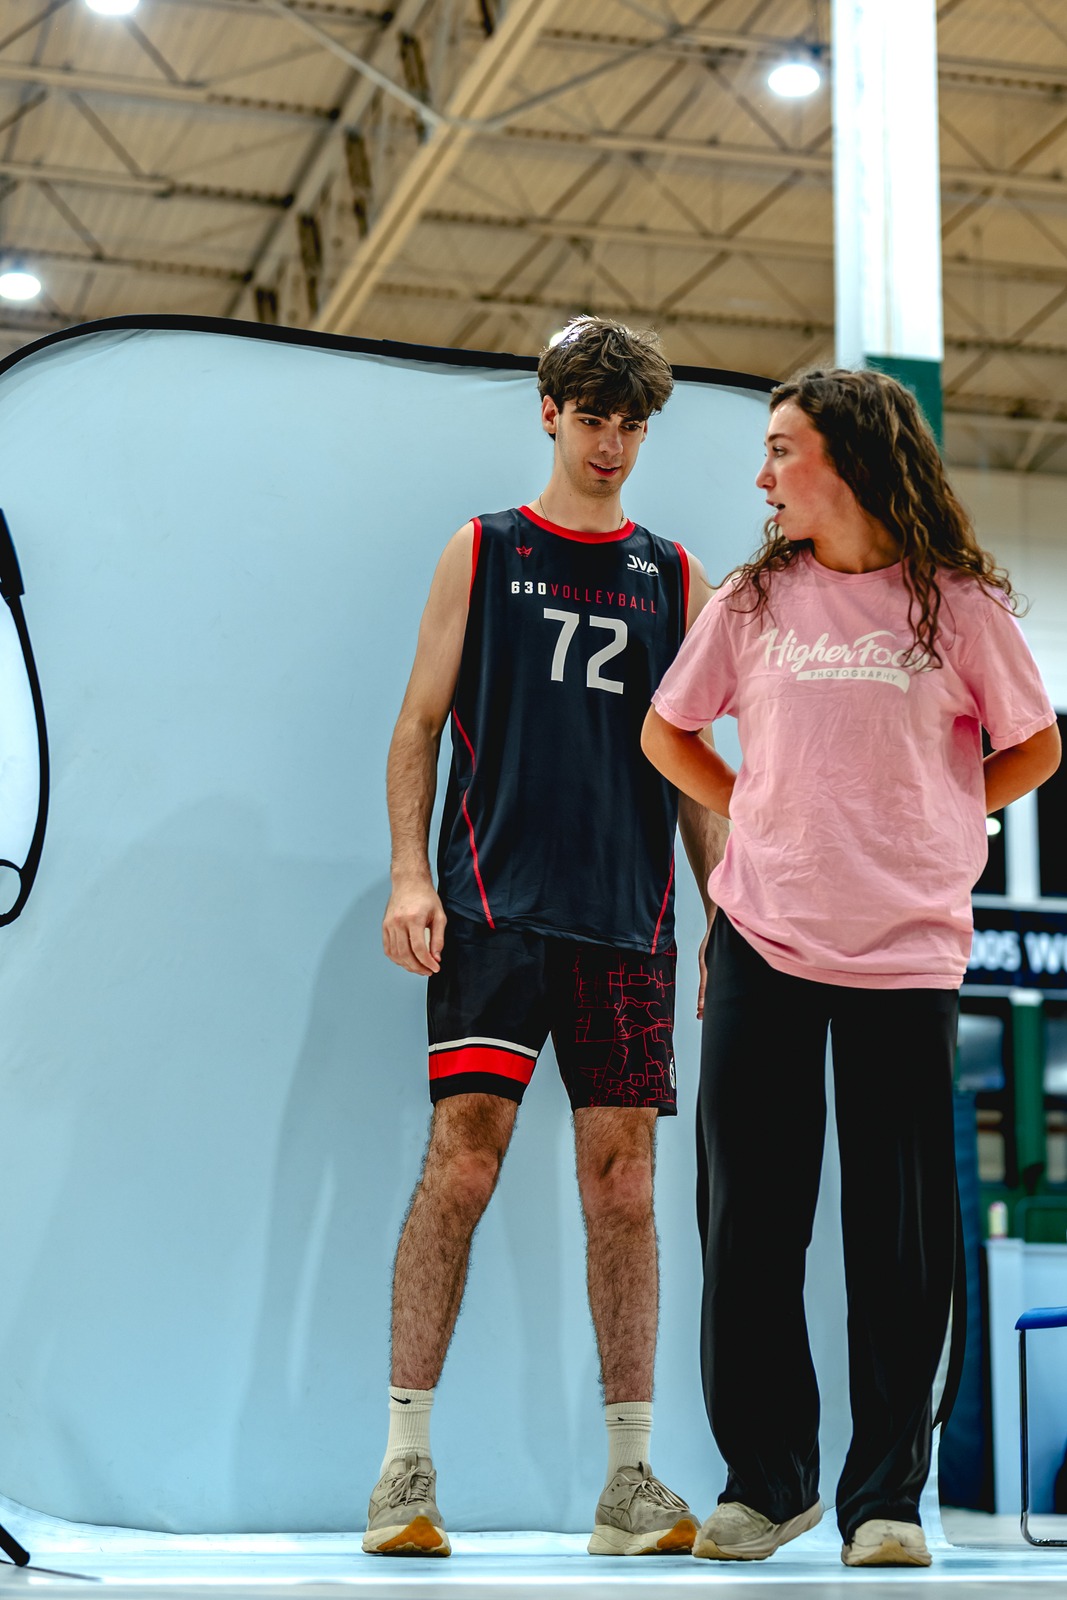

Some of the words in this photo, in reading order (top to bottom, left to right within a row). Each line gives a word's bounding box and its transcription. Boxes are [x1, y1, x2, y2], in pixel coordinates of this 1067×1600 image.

[627, 554, 659, 575] JVA
[543, 607, 628, 694] 72
[759, 628, 856, 673] Higher
[810, 669, 898, 682] PHOTOGRAPHY
[1024, 930, 1067, 975] W
